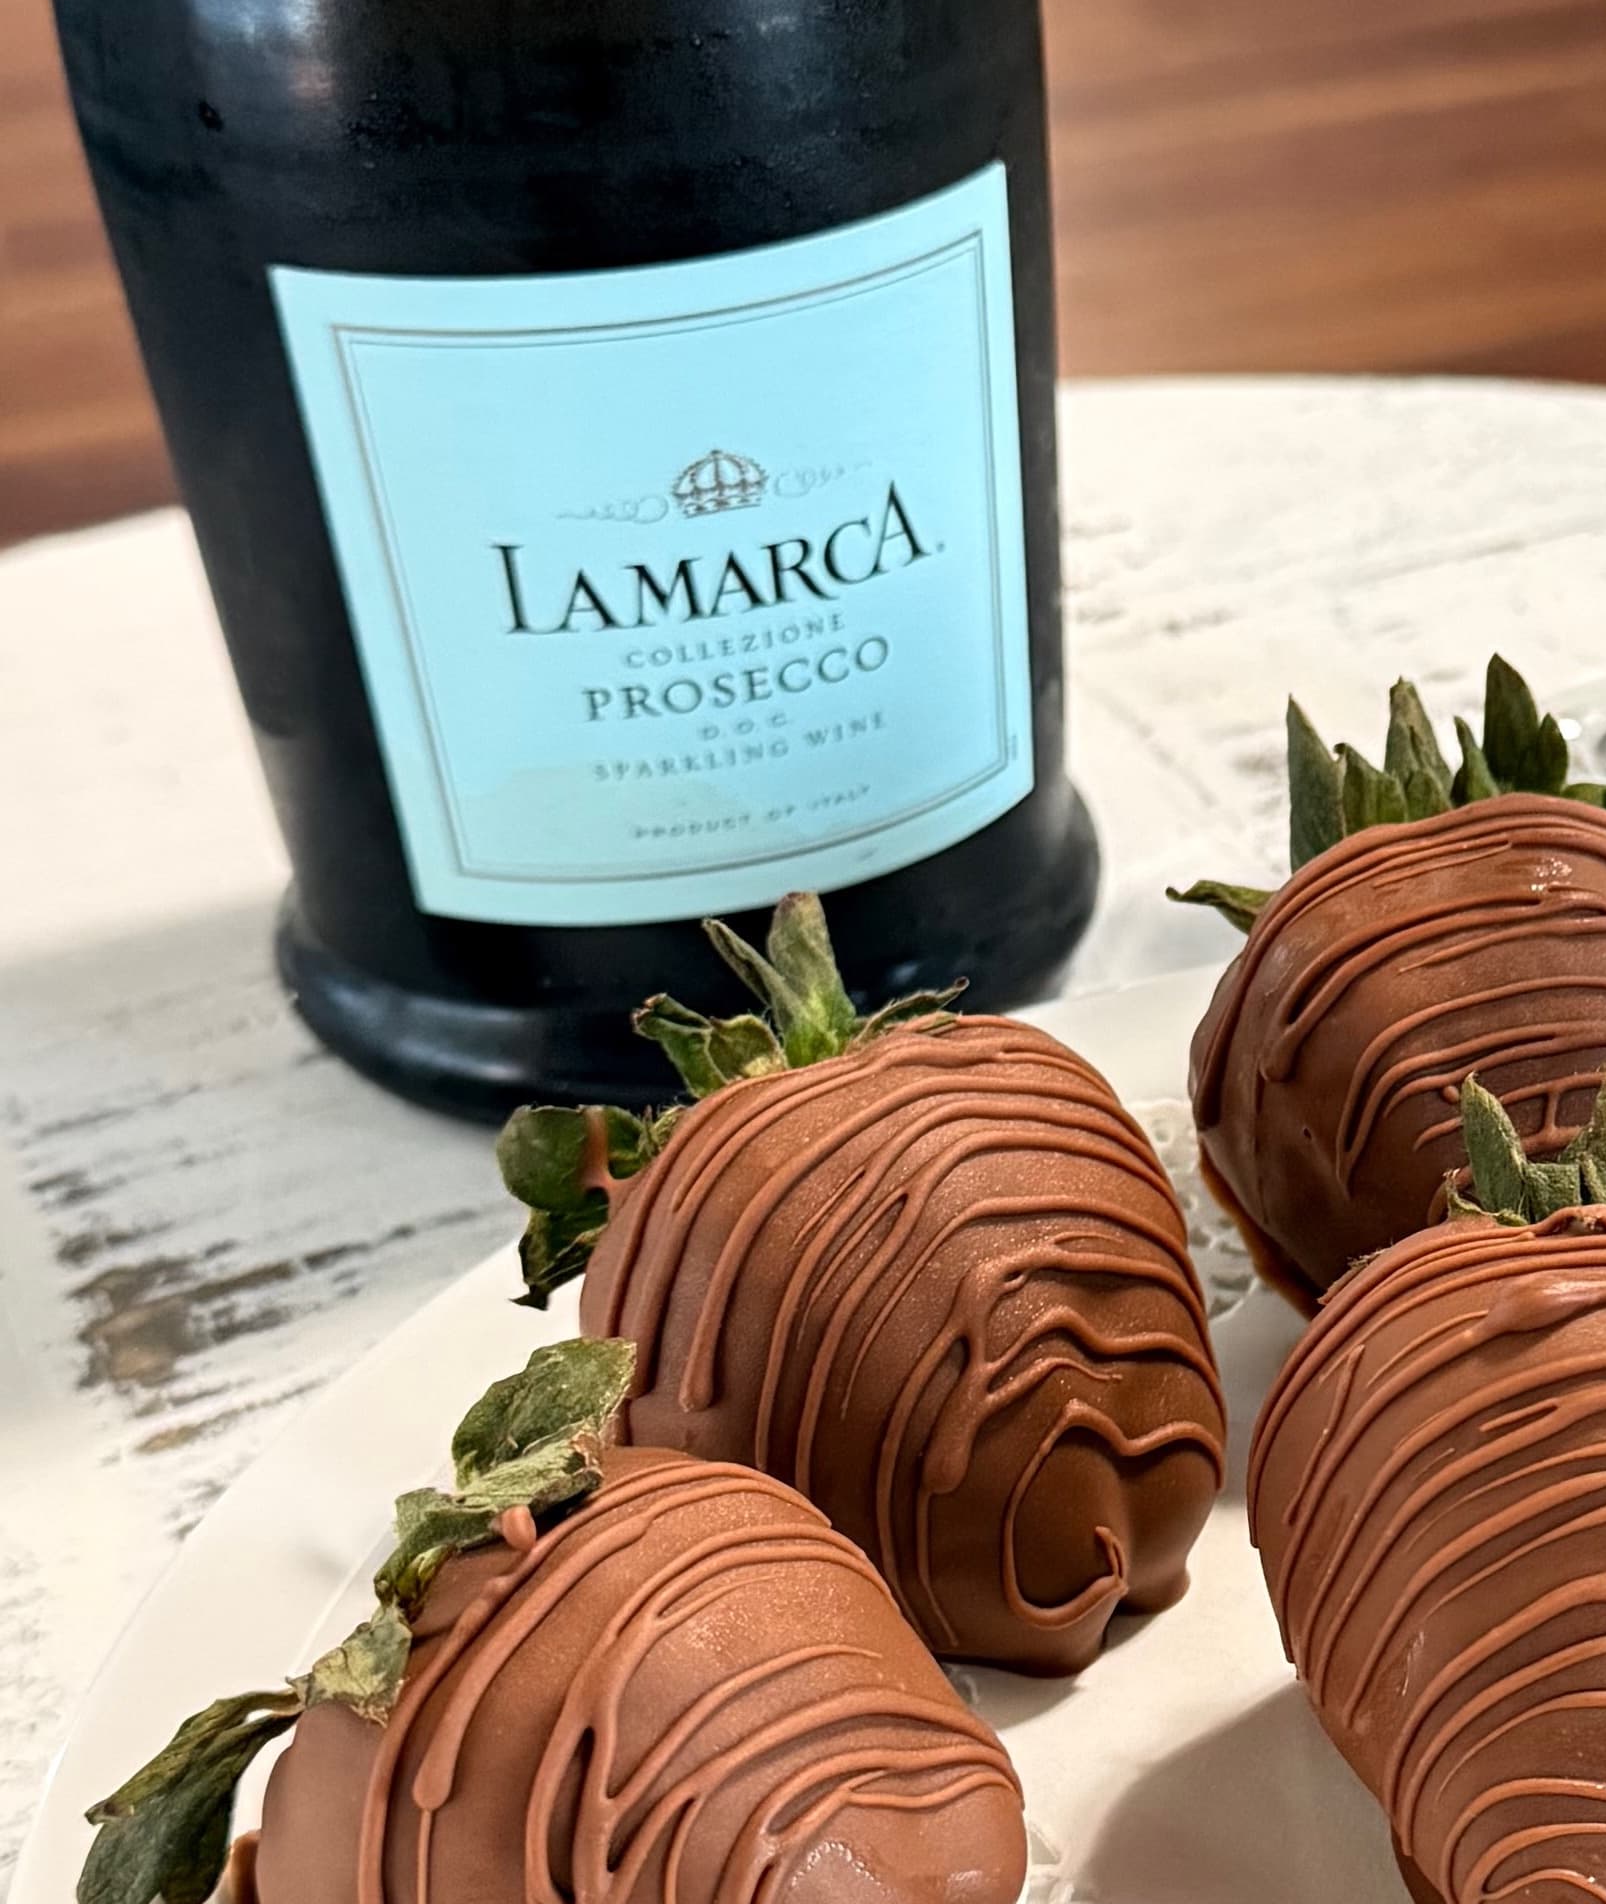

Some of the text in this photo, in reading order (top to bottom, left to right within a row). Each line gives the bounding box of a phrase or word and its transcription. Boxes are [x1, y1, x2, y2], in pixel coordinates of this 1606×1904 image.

[624, 612, 845, 669] COLLEZIONE
[582, 635, 889, 722] PROSECCO
[594, 710, 888, 781] SPARKLING WINE
